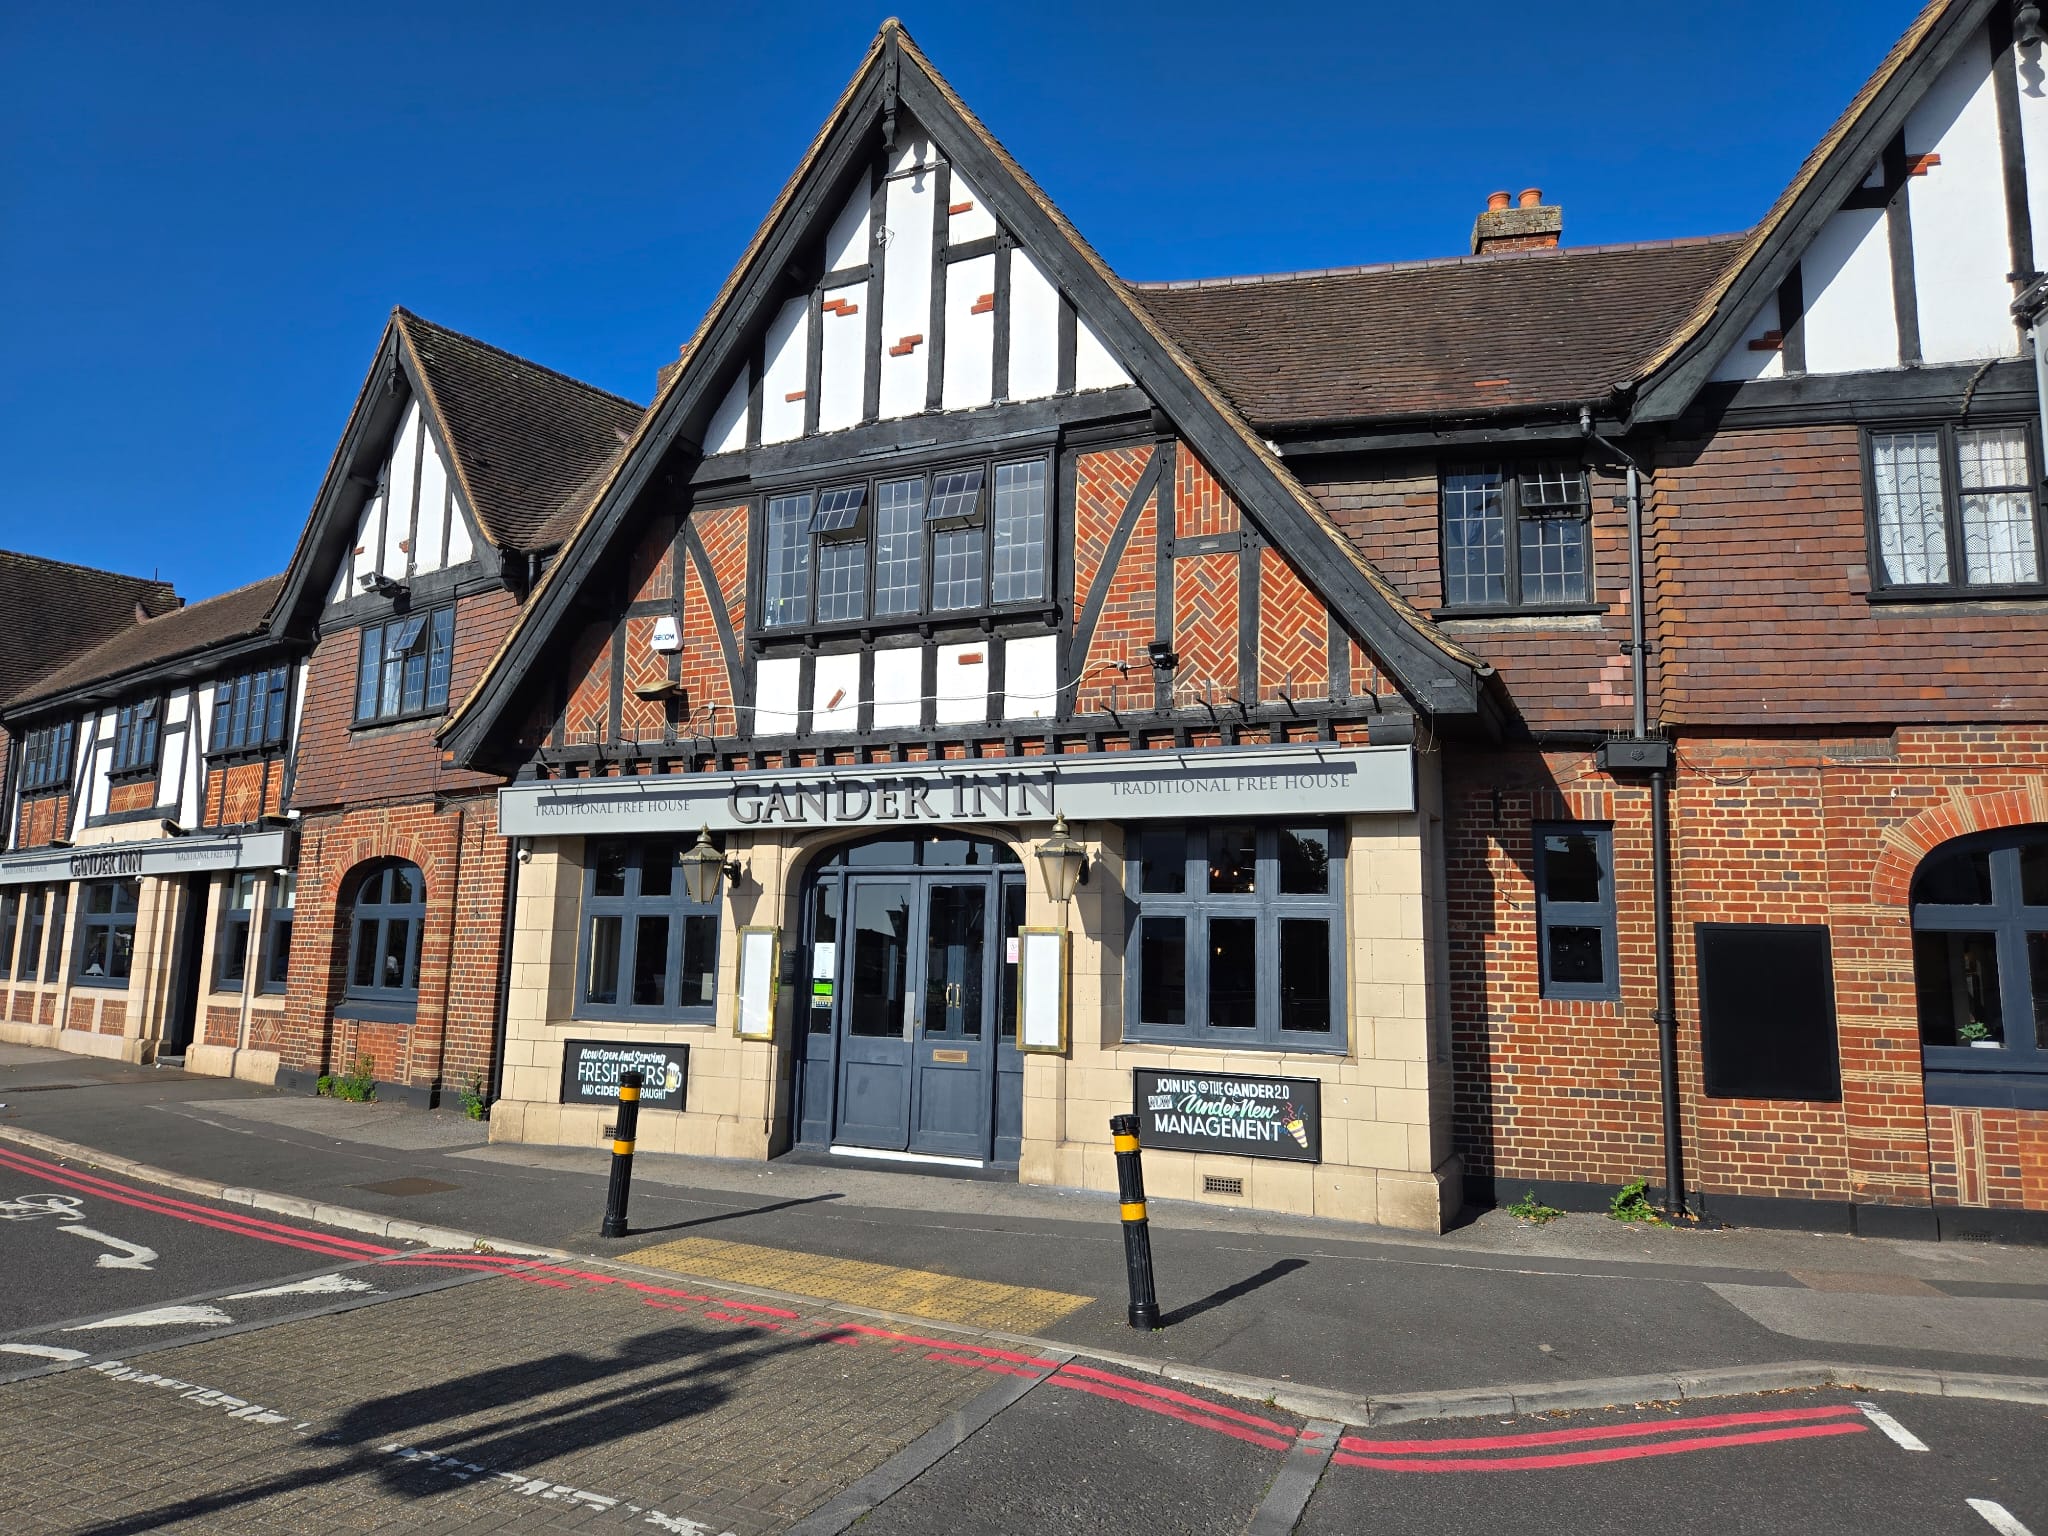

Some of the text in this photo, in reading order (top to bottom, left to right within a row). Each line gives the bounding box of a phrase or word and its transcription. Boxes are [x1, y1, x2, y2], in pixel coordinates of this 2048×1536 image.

[1110, 773, 1350, 796] TRADITIONAL FREE HOUSE
[534, 799, 690, 817] TRADITIONAL FREE HOUSE
[727, 770, 1057, 825] GANDER INN
[70, 848, 143, 877] GANDER INN
[598, 1049, 618, 1062] Open
[634, 1051, 666, 1065] Serving
[578, 1062, 618, 1082] FRESH
[582, 1084, 594, 1095] AND
[640, 1088, 666, 1100] RAUGHT
[1156, 1078, 1180, 1093] JOIN
[1182, 1080, 1196, 1094] US
[1224, 1083, 1274, 1099] GANDER
[1274, 1085, 1290, 1100] 2.0
[1177, 1093, 1239, 1118] Under
[1232, 1096, 1279, 1119] New
[1154, 1113, 1281, 1142] MANAGEMENT
